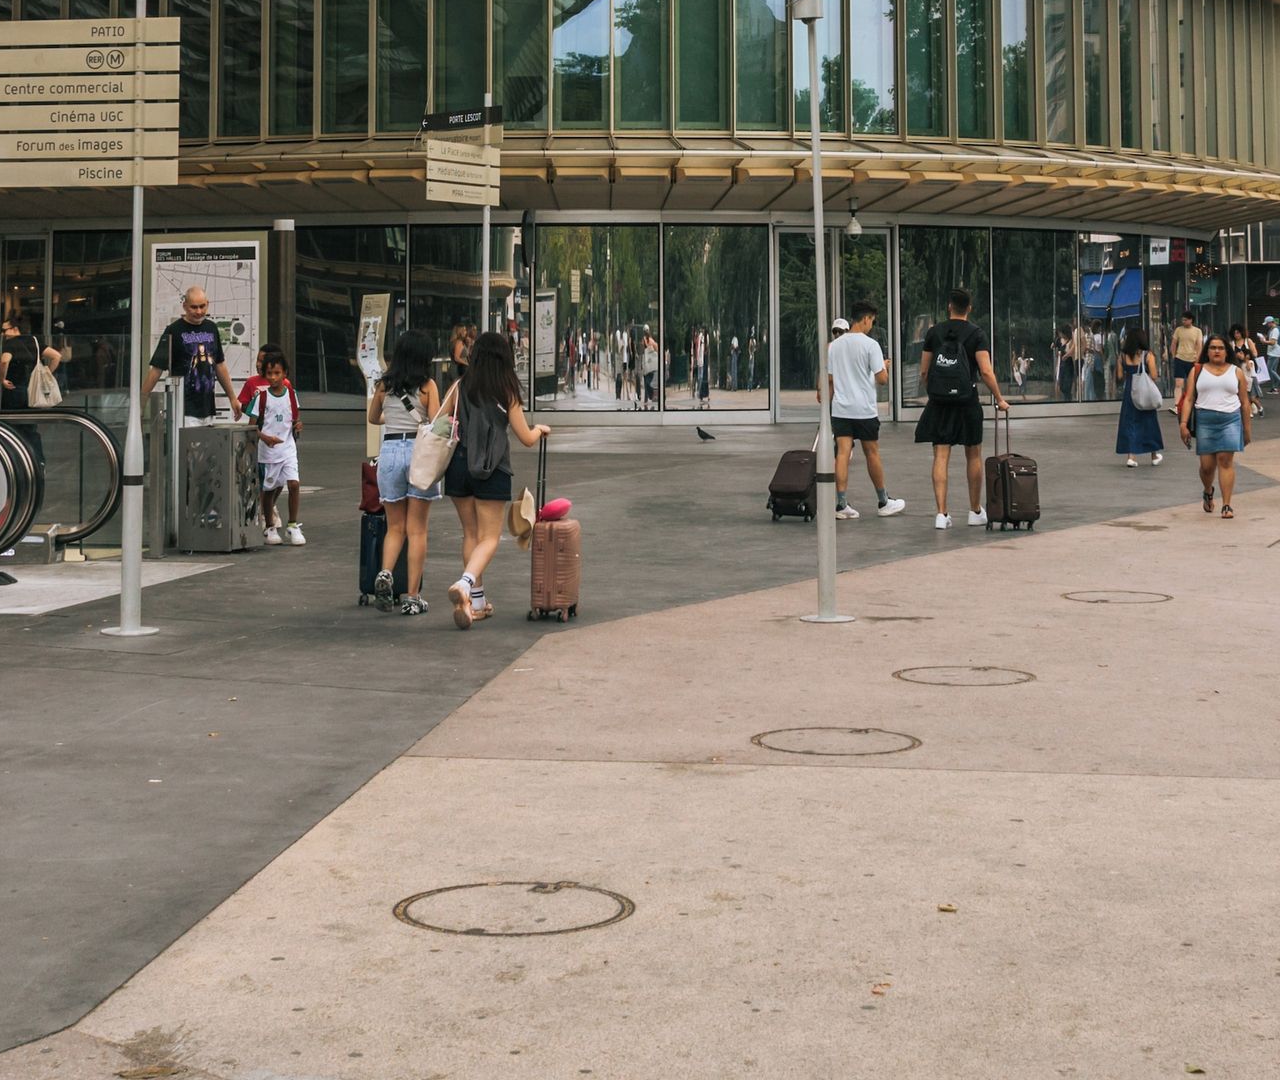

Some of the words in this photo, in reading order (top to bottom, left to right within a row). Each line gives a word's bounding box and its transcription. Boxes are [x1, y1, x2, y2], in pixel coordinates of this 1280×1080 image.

[91, 26, 125, 37] PATIO
[88, 55, 102, 64] RER
[110, 54, 121, 64] M
[4, 83, 45, 95] Centre
[49, 81, 124, 94] commercial
[50, 110, 96, 123] Cinéma
[100, 110, 124, 122] UGC
[449, 115, 464, 124] PORTE
[465, 113, 482, 123] LESCOT
[16, 140, 56, 152] Forum
[58, 141, 75, 151] des
[77, 139, 123, 153] images
[78, 168, 123, 179] Piscine
[275, 414, 283, 422] 10
